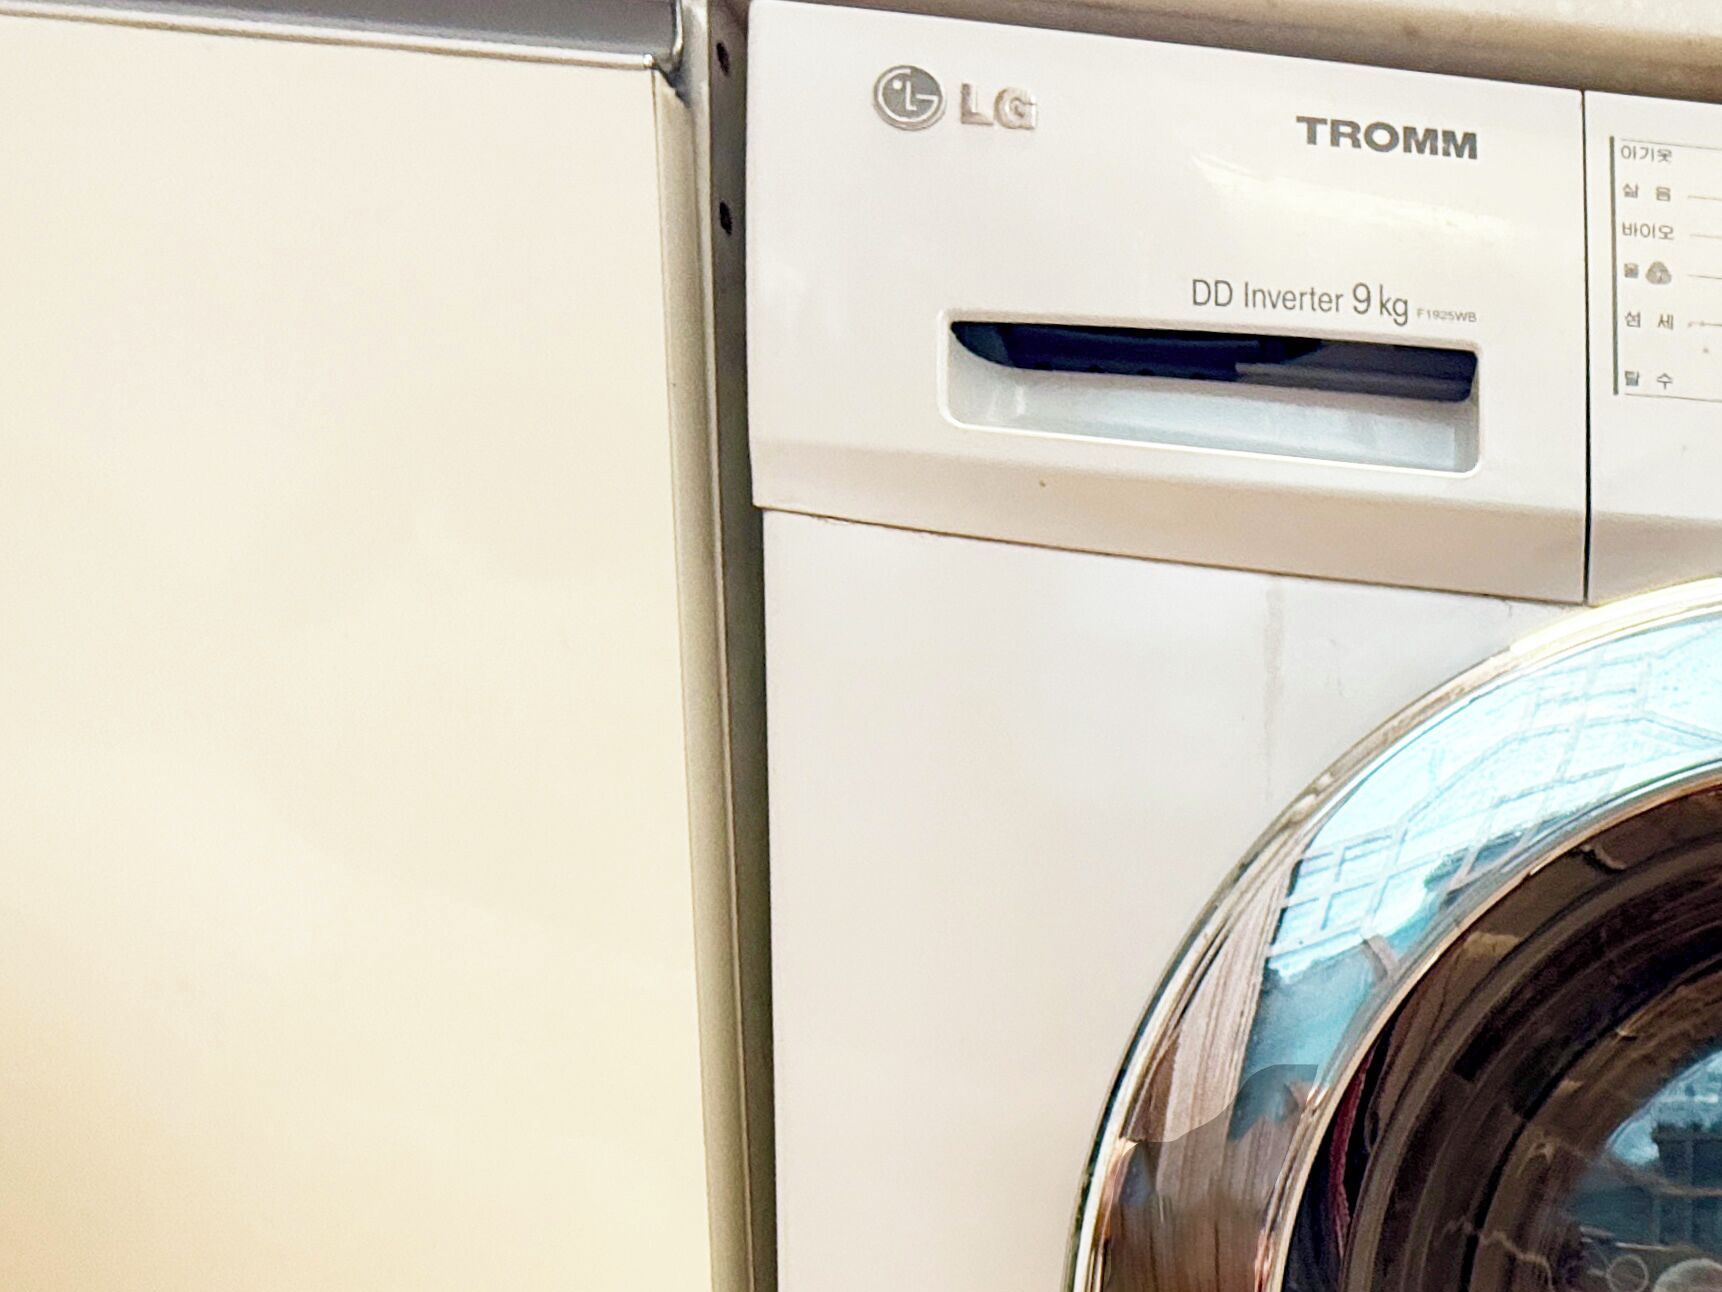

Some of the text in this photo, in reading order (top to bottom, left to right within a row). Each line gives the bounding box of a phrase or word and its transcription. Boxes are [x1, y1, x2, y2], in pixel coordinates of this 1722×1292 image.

[959, 82, 1037, 131] LG
[1295, 115, 1478, 160] TROMM
[1621, 221, 1675, 241] 바이오
[1191, 278, 1234, 308] DD
[1243, 281, 1344, 313] Inverter
